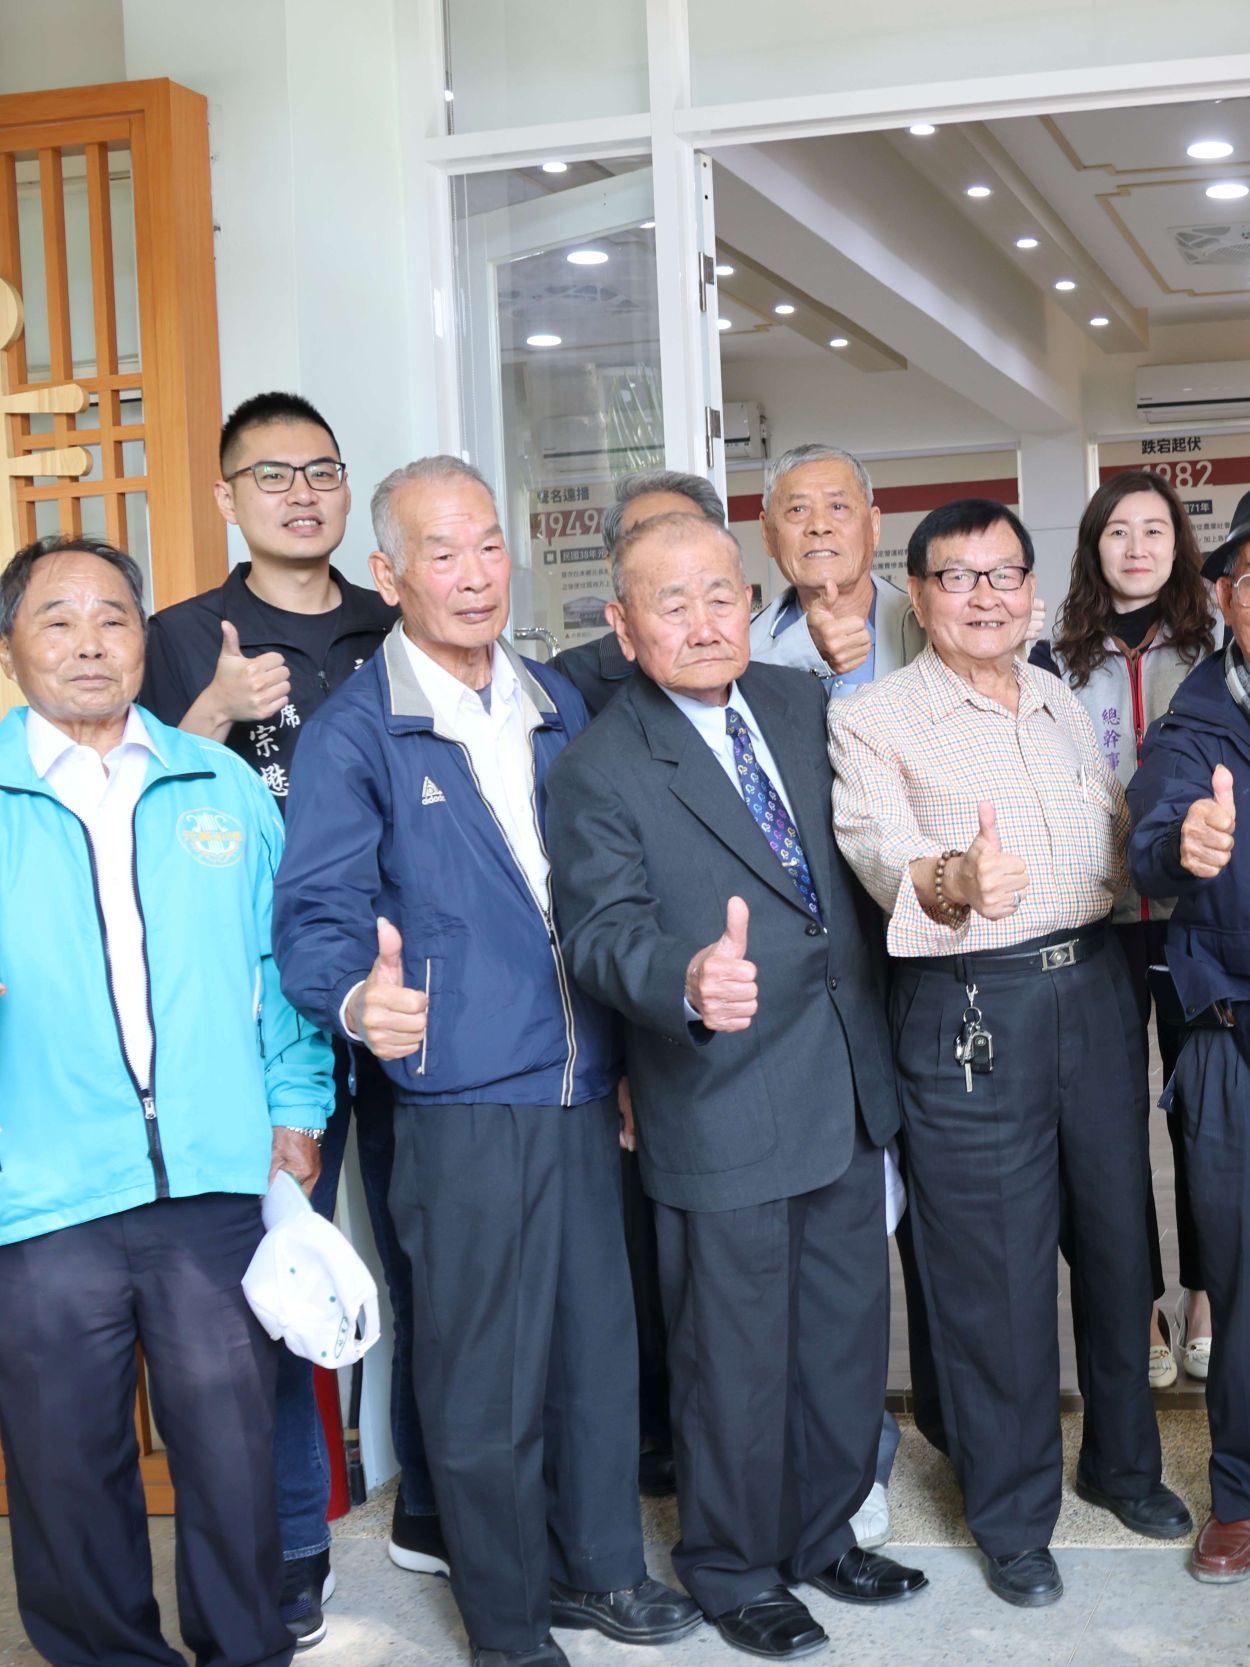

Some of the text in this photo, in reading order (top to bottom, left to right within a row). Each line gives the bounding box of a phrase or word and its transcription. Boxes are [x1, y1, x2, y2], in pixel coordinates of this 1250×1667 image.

[1142, 436, 1202, 455] 跌宕起伏
[1141, 461, 1214, 490] 982
[1101, 707, 1121, 771] 總幹事
